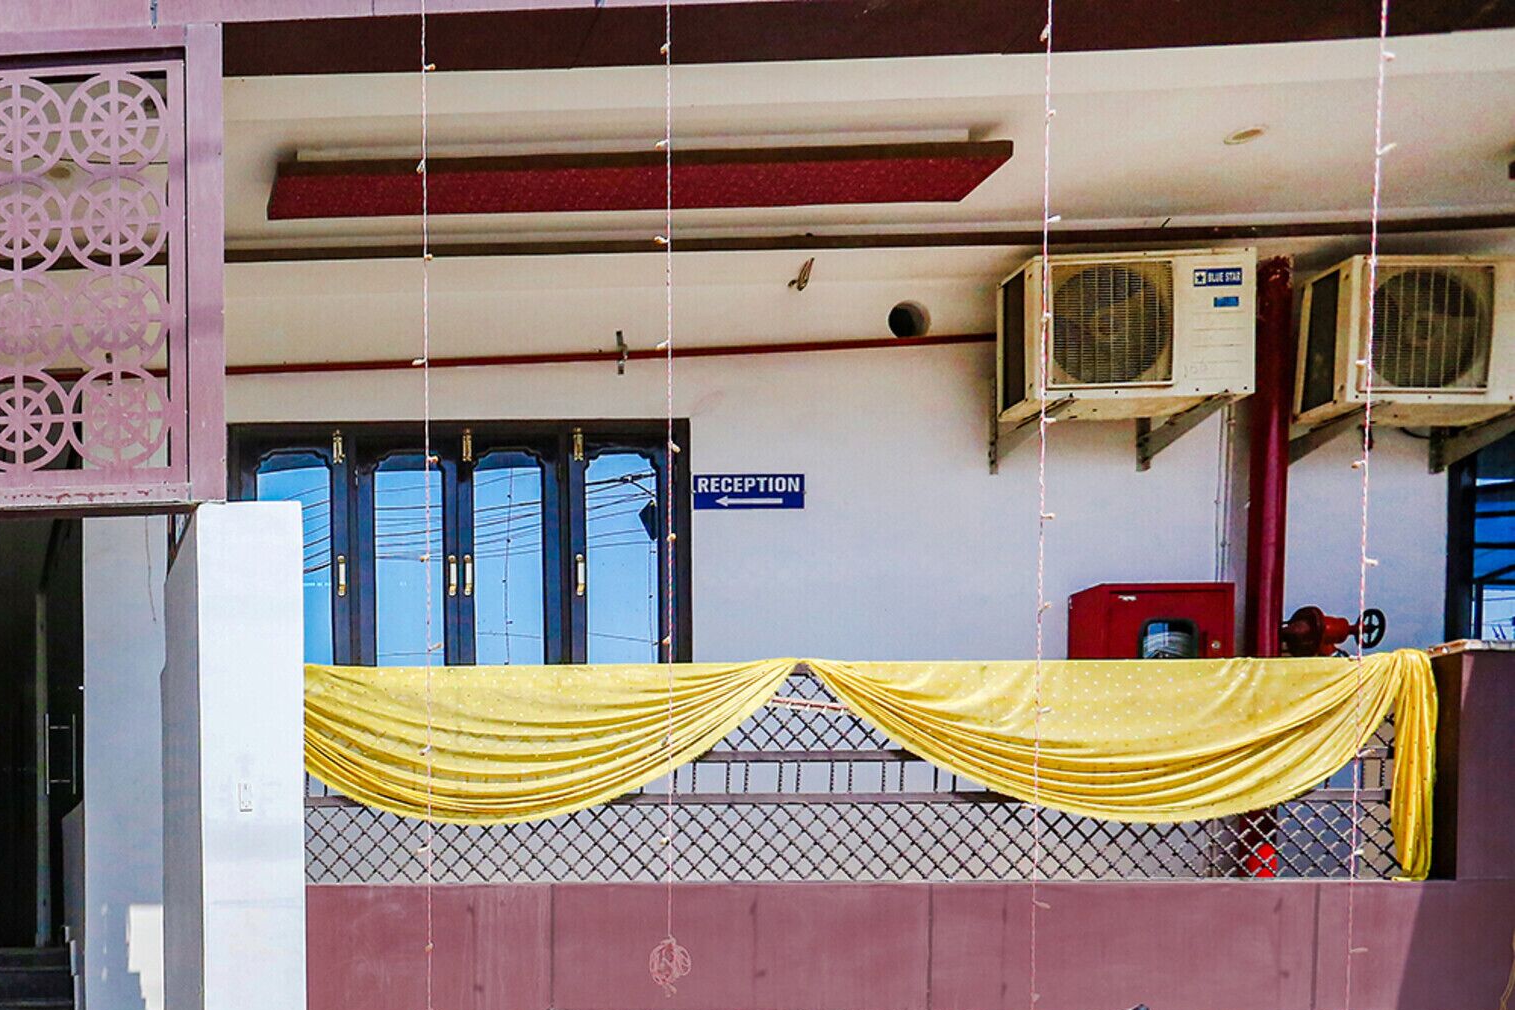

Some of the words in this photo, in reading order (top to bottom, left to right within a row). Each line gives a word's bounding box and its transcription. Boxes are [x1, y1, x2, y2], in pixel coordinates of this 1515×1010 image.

[1207, 271, 1224, 283] BLUE
[1225, 270, 1241, 283] STAR
[697, 476, 800, 493] RECEPTION
